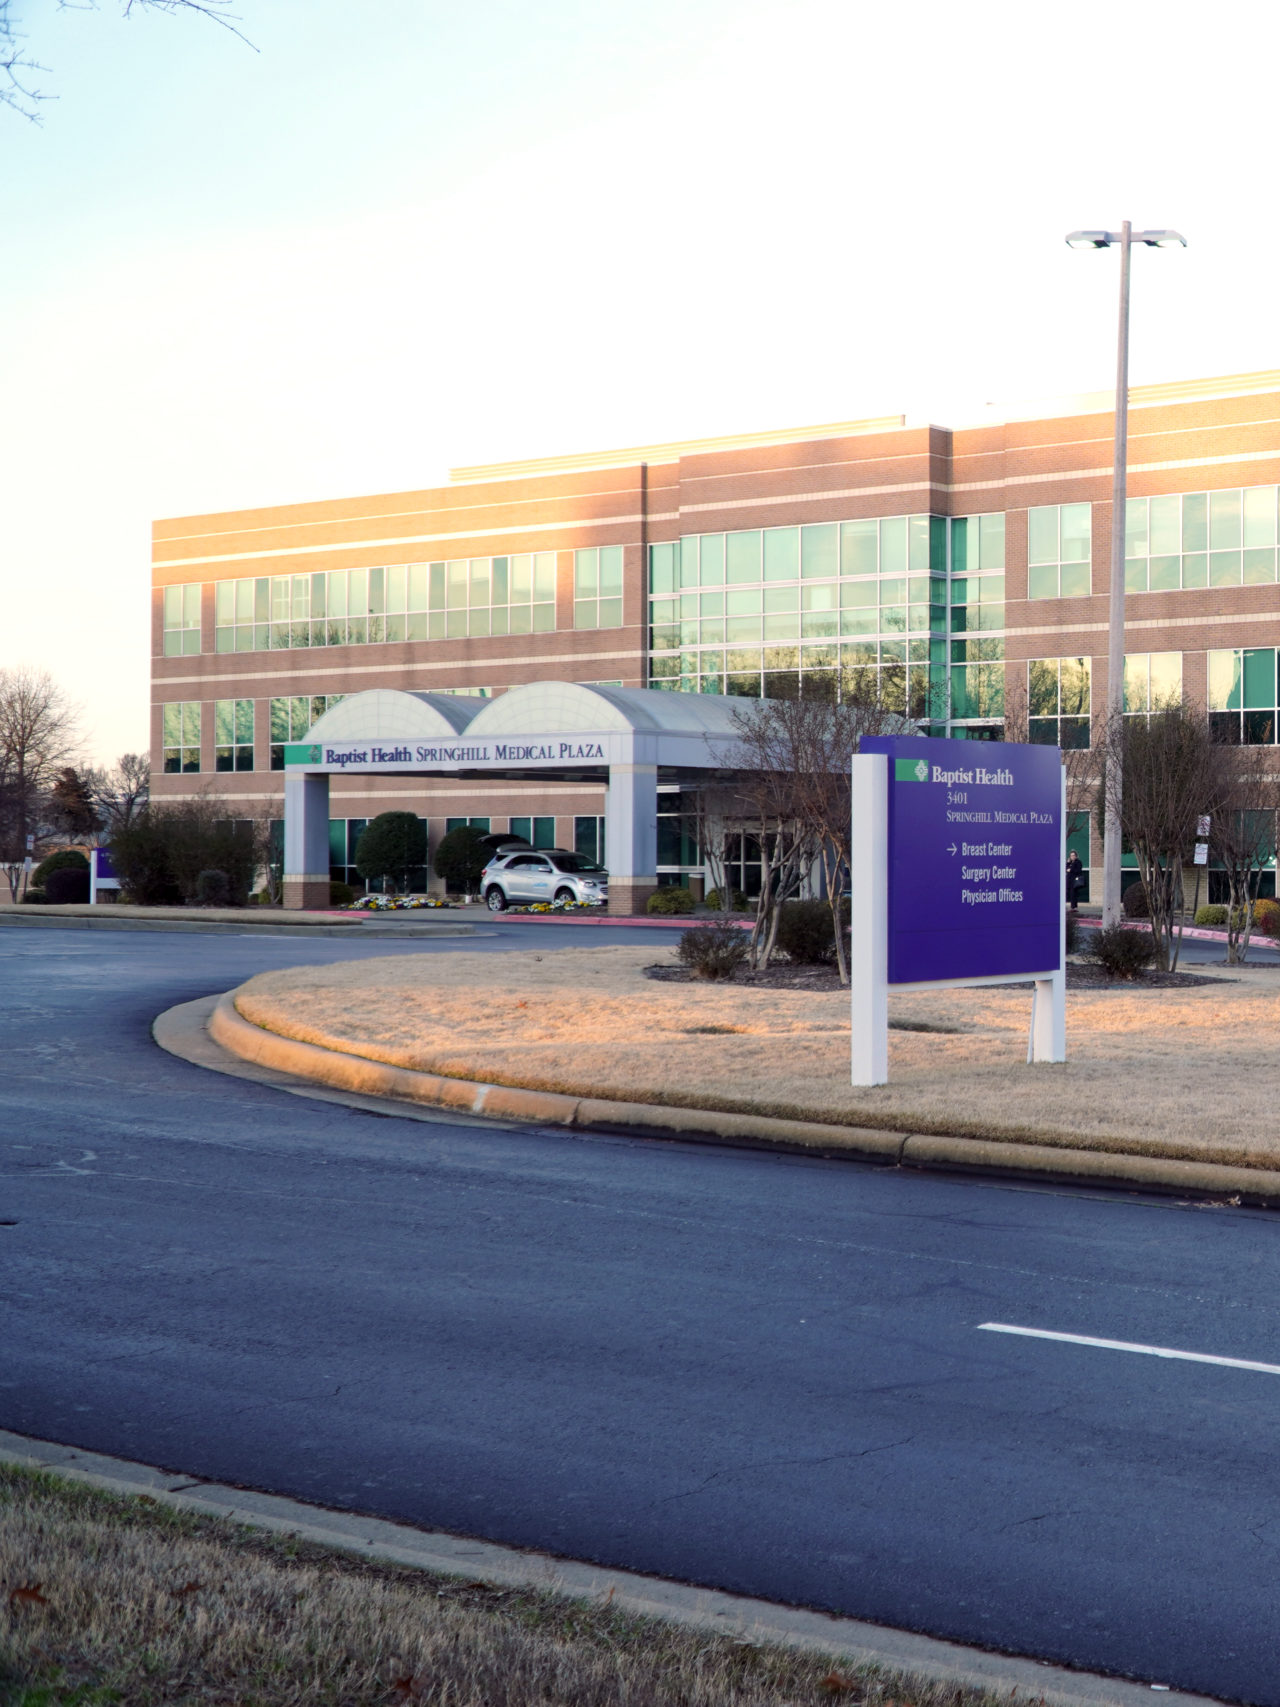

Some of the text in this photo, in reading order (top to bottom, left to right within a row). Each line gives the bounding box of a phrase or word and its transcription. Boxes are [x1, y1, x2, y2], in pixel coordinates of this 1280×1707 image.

[325, 743, 604, 767] Baptist Health SPRINGHILL MEDICAL PLAZA
[932, 765, 1014, 787] Baptist Health
[946, 791, 968, 805] 3401
[946, 811, 1053, 824] SPRINGHILL MEDICAL PLAZA
[962, 842, 1012, 857] Breast Center
[962, 865, 1016, 882] Surgery Center
[962, 888, 1023, 906] Physician Offices
